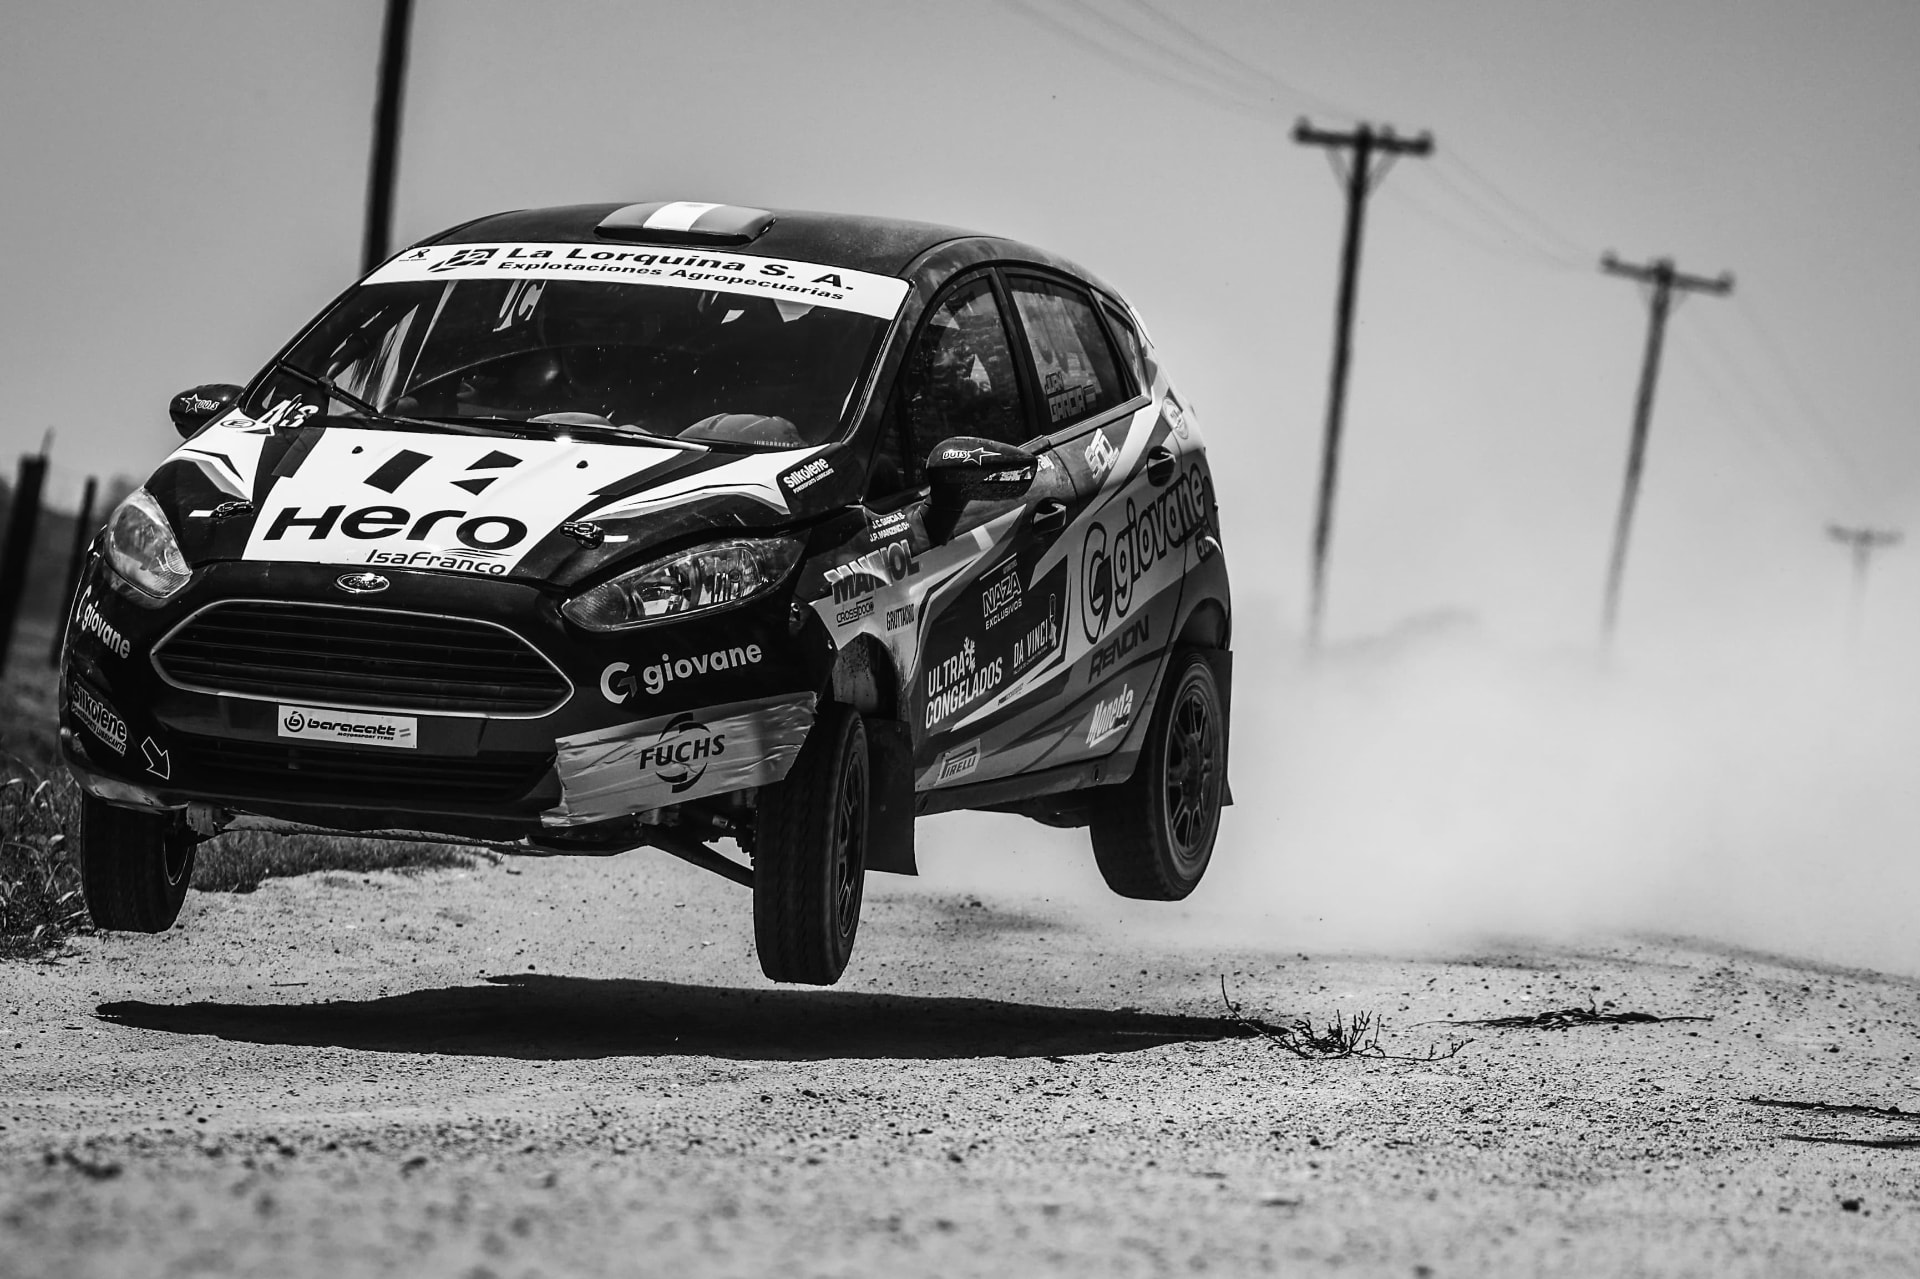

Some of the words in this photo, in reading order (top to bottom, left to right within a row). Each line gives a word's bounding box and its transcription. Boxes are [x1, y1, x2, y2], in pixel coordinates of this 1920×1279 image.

[498, 260, 662, 278] Explotaciones
[675, 267, 844, 301] Agropecuarias
[507, 247, 553, 259] La
[572, 248, 746, 273] Lorquina
[760, 263, 795, 279] S.
[816, 272, 854, 291] A.
[783, 458, 829, 489] Silkolene
[263, 505, 528, 551] Hero
[1113, 463, 1204, 619] giovane
[982, 569, 1022, 618] NAZA
[985, 598, 1023, 630] EXCLUSIVOS
[82, 600, 131, 660] giovane
[1013, 639, 1024, 669] DA
[1026, 618, 1048, 658] VINCI
[643, 643, 762, 695] giovane
[925, 656, 1003, 729] CONGELADOS
[927, 651, 966, 698] ULTRA
[72, 681, 128, 743] Silkolene
[307, 717, 397, 736] baracatt
[1085, 683, 1134, 745] Moneda
[639, 734, 726, 770] FUCHS
[940, 746, 977, 780] PIRELLI
